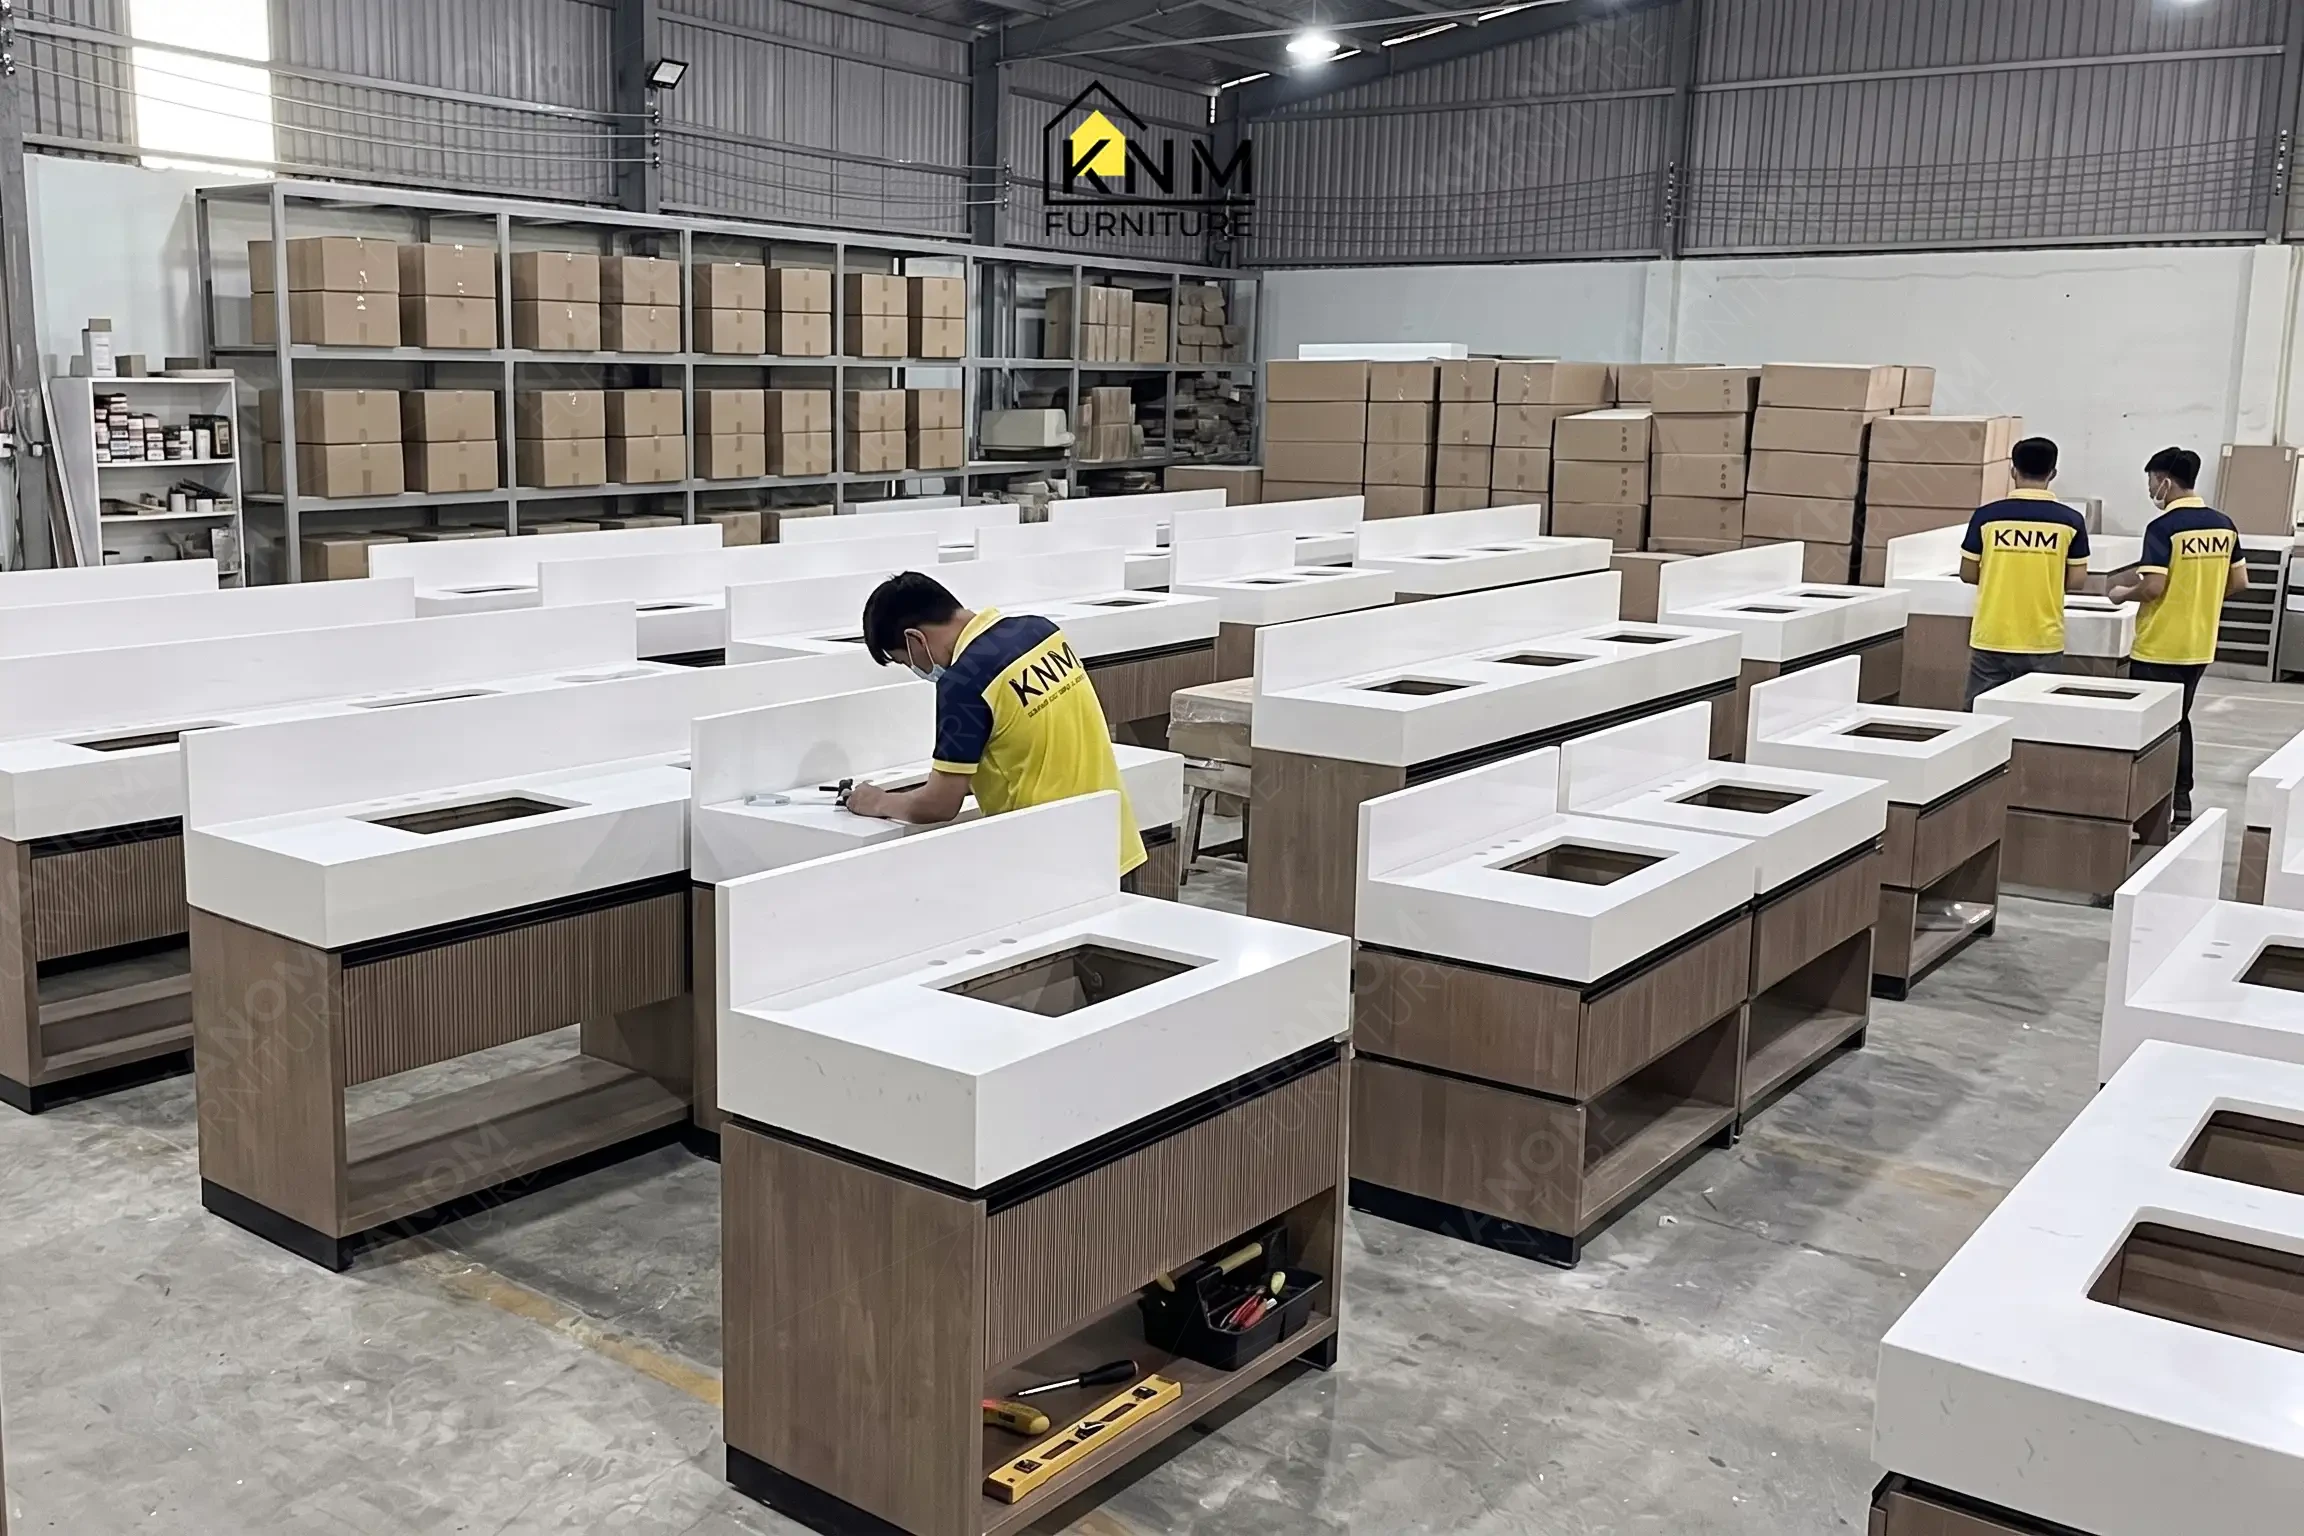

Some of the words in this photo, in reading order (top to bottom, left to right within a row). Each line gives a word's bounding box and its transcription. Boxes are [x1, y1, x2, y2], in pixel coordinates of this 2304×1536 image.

[1993, 529, 2059, 550] KNM
[2181, 535, 2230, 555] KNM
[1008, 641, 1082, 708] KNM
